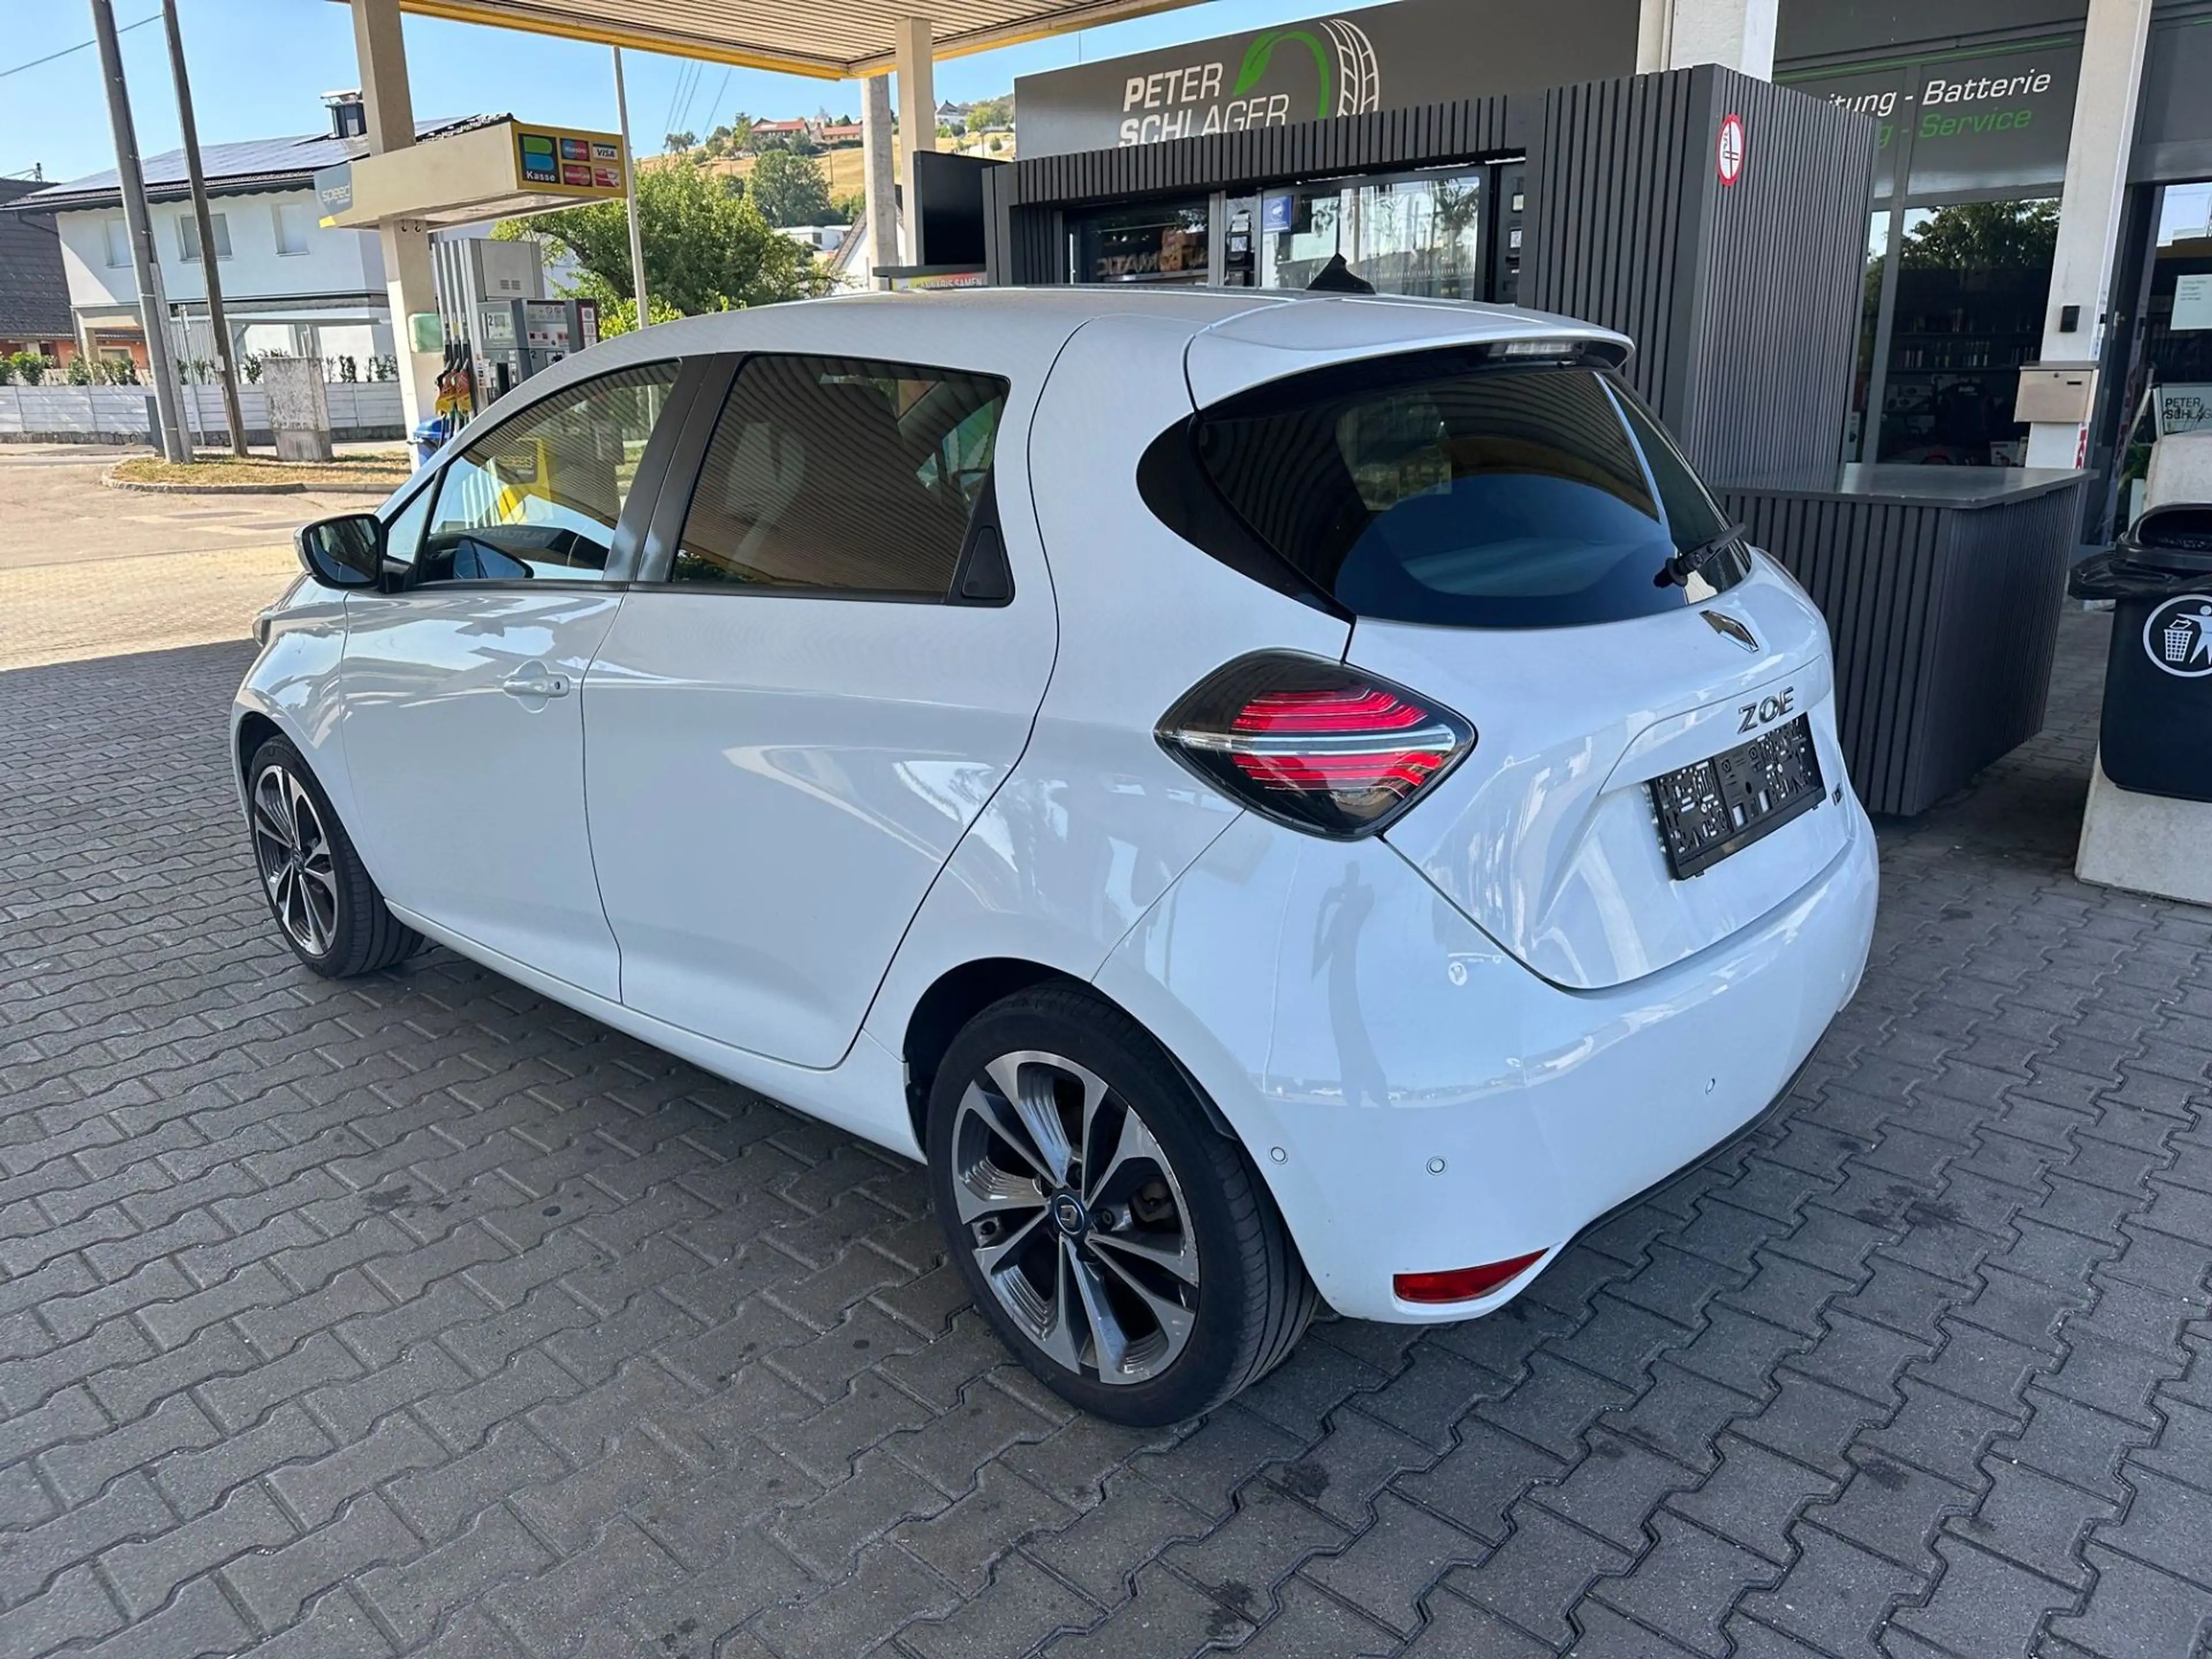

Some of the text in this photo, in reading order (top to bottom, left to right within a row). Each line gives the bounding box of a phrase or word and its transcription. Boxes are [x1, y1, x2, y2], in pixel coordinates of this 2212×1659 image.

[1123, 62, 1224, 112] PETER
[1922, 69, 2051, 105] Batterie
[1118, 93, 1290, 147] SCHLAGER
[1919, 107, 2033, 139] Service
[596, 148, 616, 158] VISA
[526, 169, 556, 182] Kasse
[321, 182, 351, 203] speed
[530, 350, 537, 359] 2
[2165, 397, 2200, 407] PETER
[1737, 686, 1794, 734] ZOE
